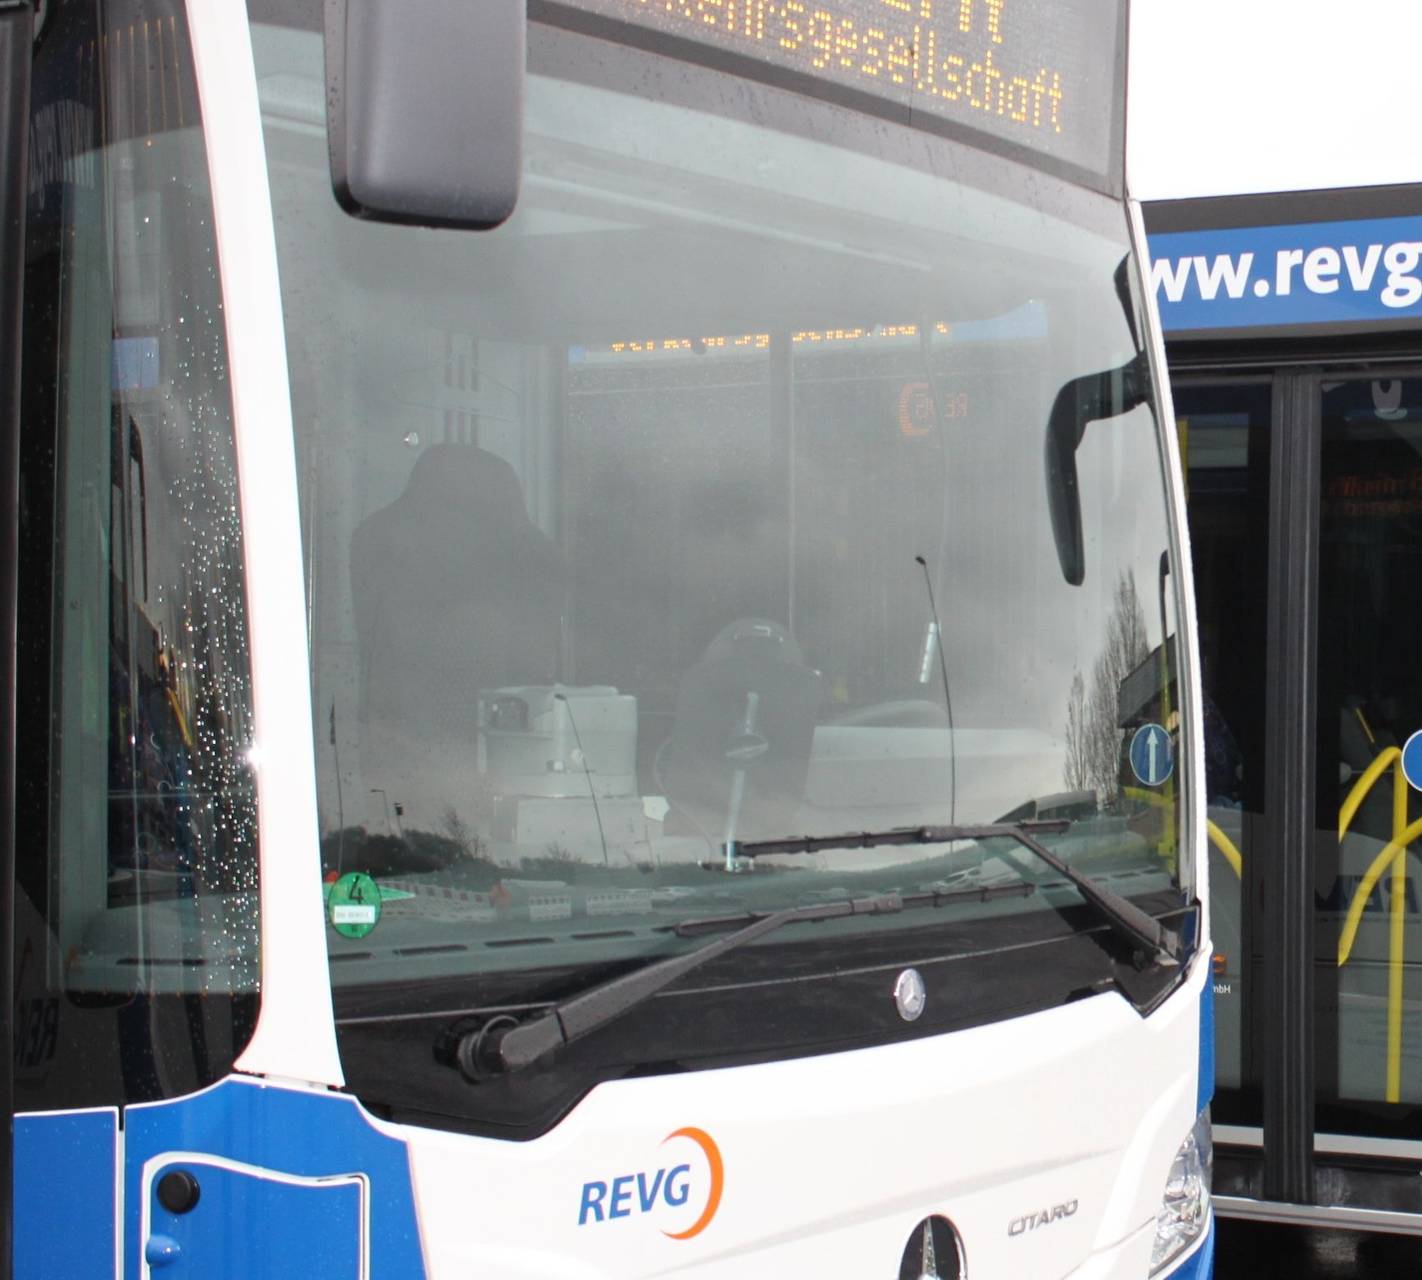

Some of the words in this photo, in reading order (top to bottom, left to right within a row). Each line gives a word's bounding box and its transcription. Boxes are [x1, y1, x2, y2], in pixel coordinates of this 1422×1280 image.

[348, 875, 364, 905] 4
[577, 1163, 693, 1226] REVG
[1008, 1199, 1079, 1237] CITARO
